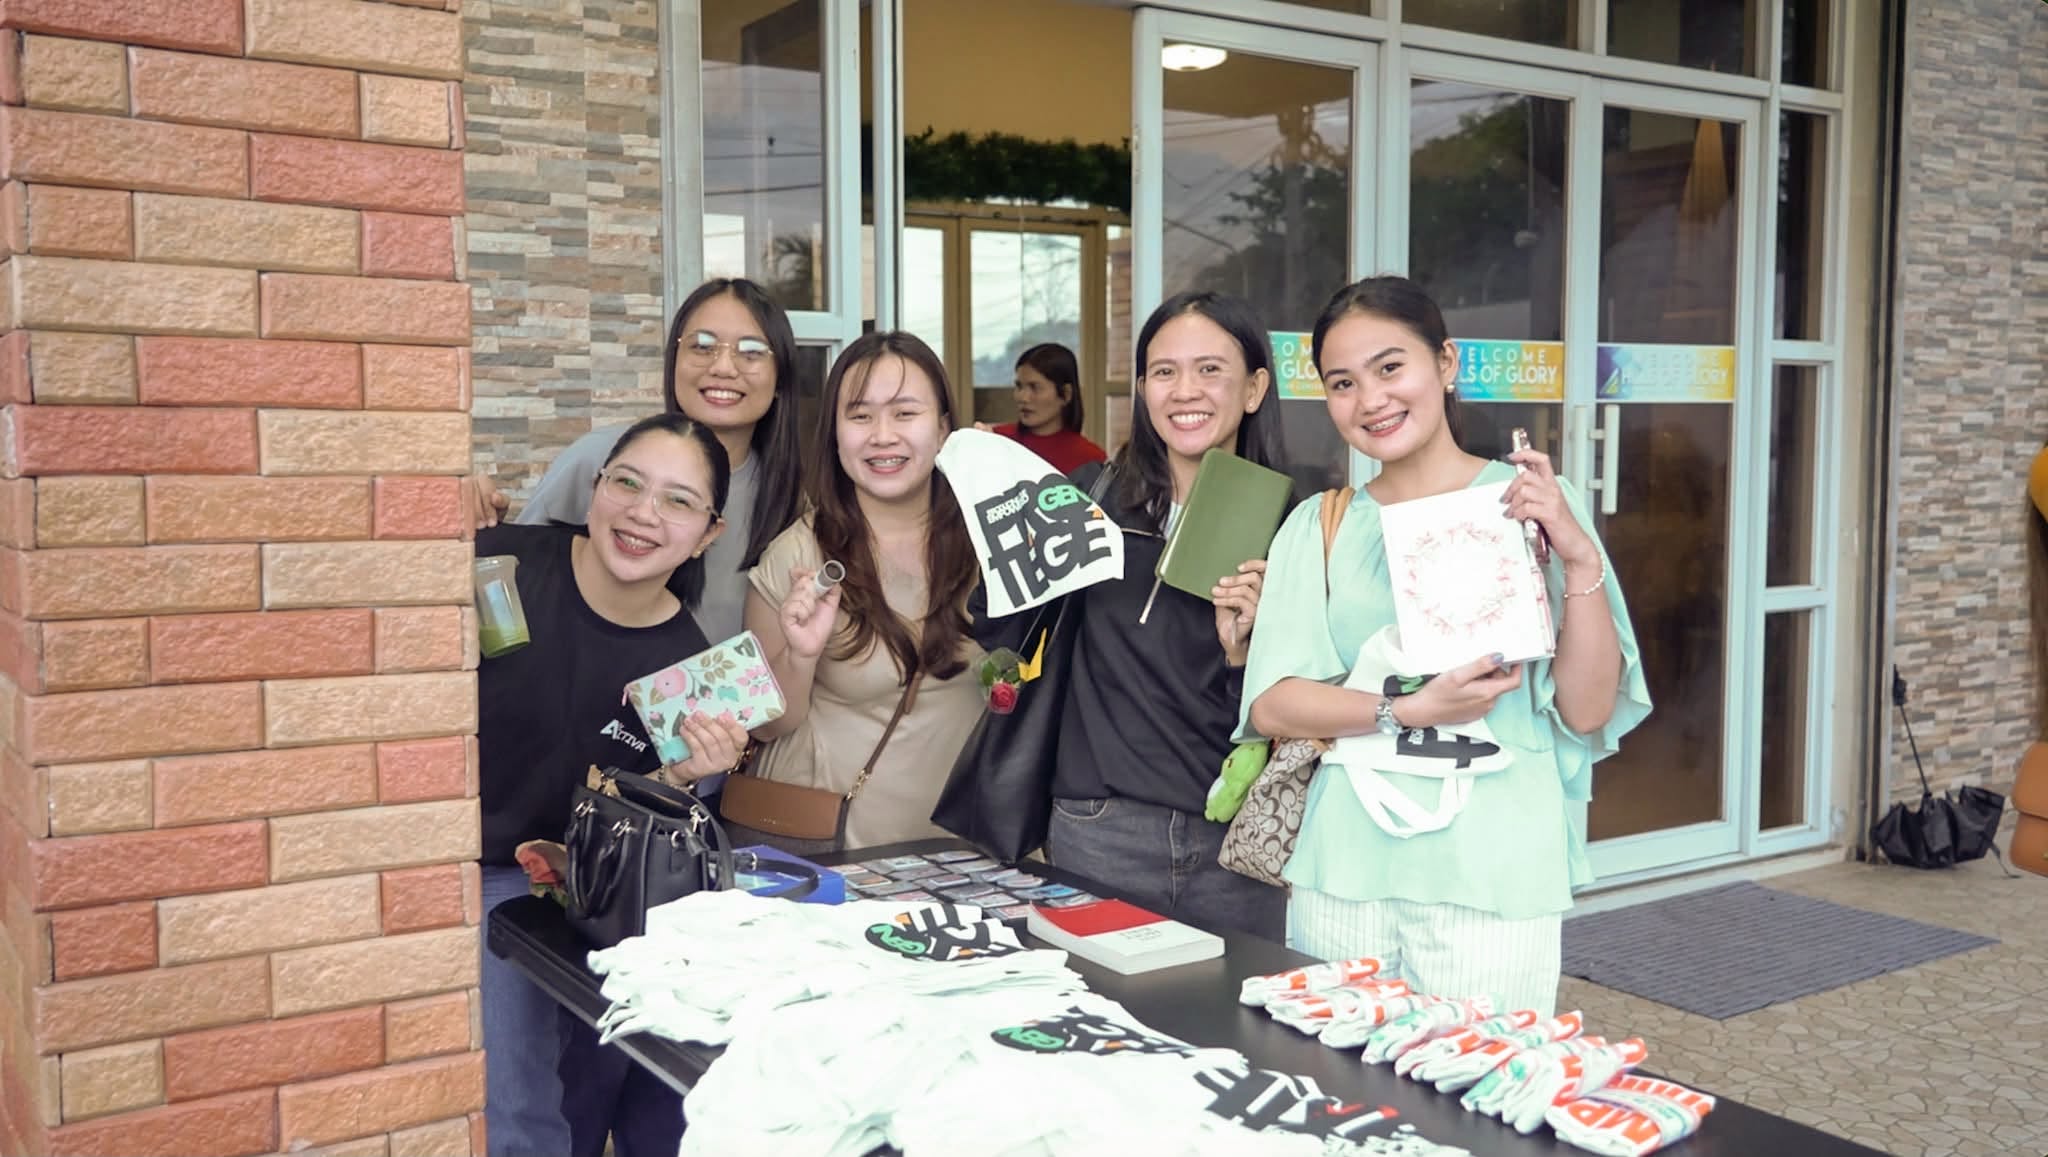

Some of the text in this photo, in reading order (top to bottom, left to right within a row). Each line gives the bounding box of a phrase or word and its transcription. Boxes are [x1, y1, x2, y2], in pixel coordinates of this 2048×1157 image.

[1457, 346, 1546, 364] ELCOME
[1281, 360, 1320, 380] GLO
[1480, 365, 1503, 384] OF
[1505, 365, 1558, 384] GLORY
